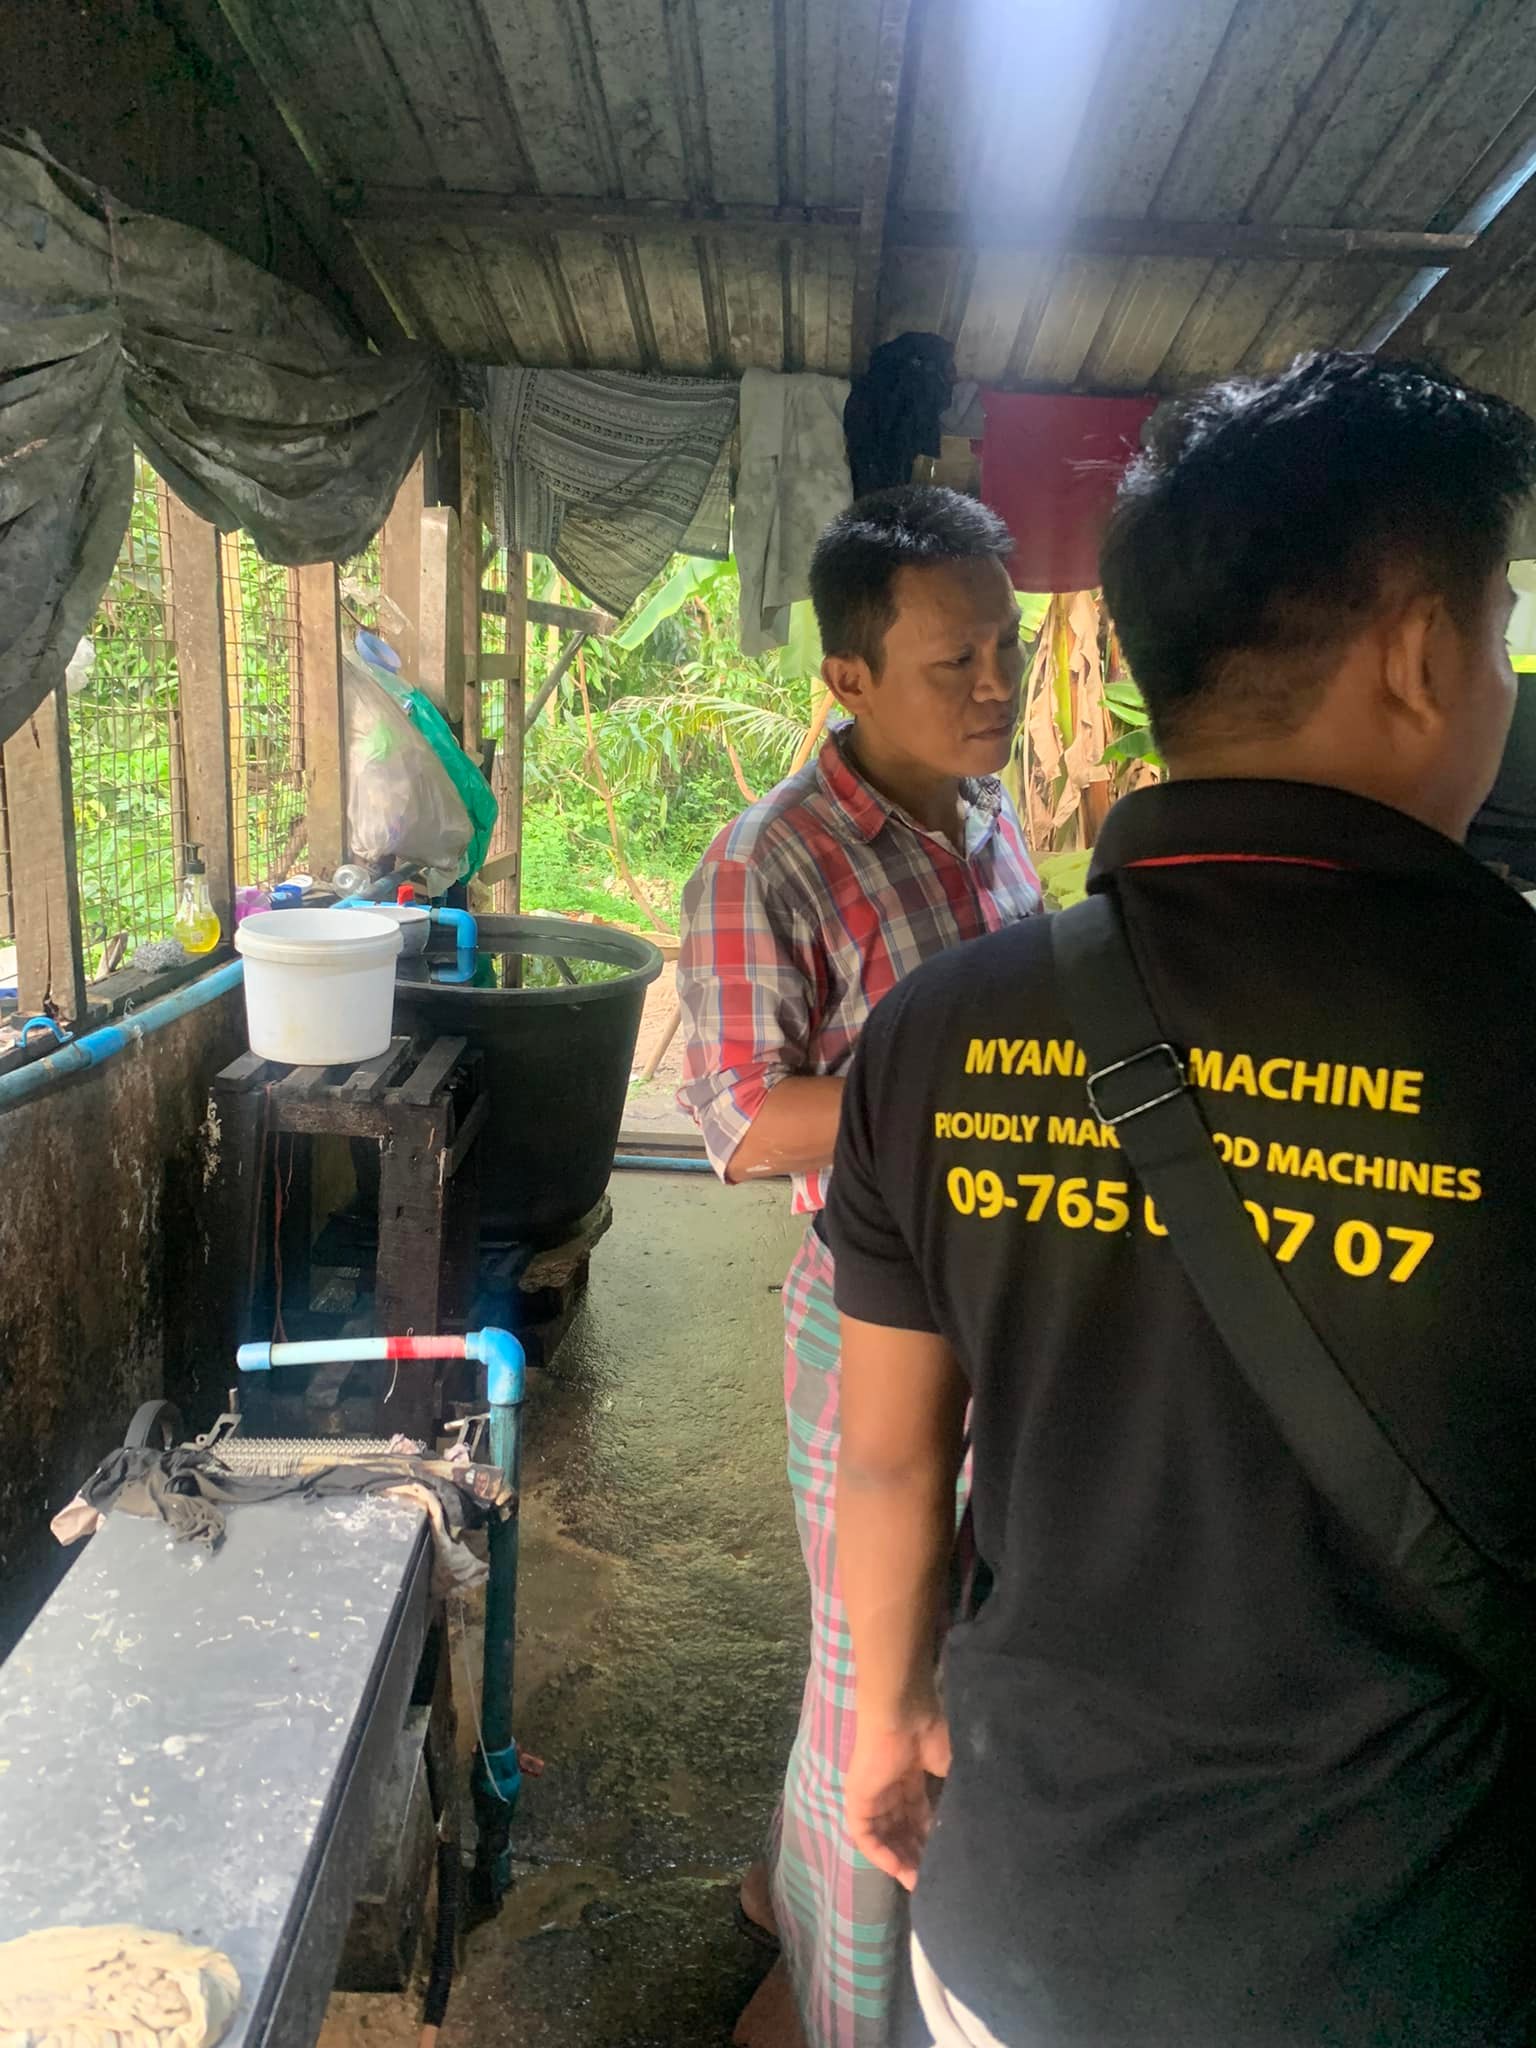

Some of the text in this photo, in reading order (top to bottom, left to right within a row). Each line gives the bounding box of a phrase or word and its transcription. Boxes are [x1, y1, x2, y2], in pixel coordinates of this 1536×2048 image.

[1188, 1047, 1424, 1114] MACHINE
[1047, 1115, 1121, 1149] MAK
[1266, 1141, 1482, 1201] MACHINES
[946, 1166, 1130, 1233] 09-765
[1333, 1219, 1435, 1283] 07
